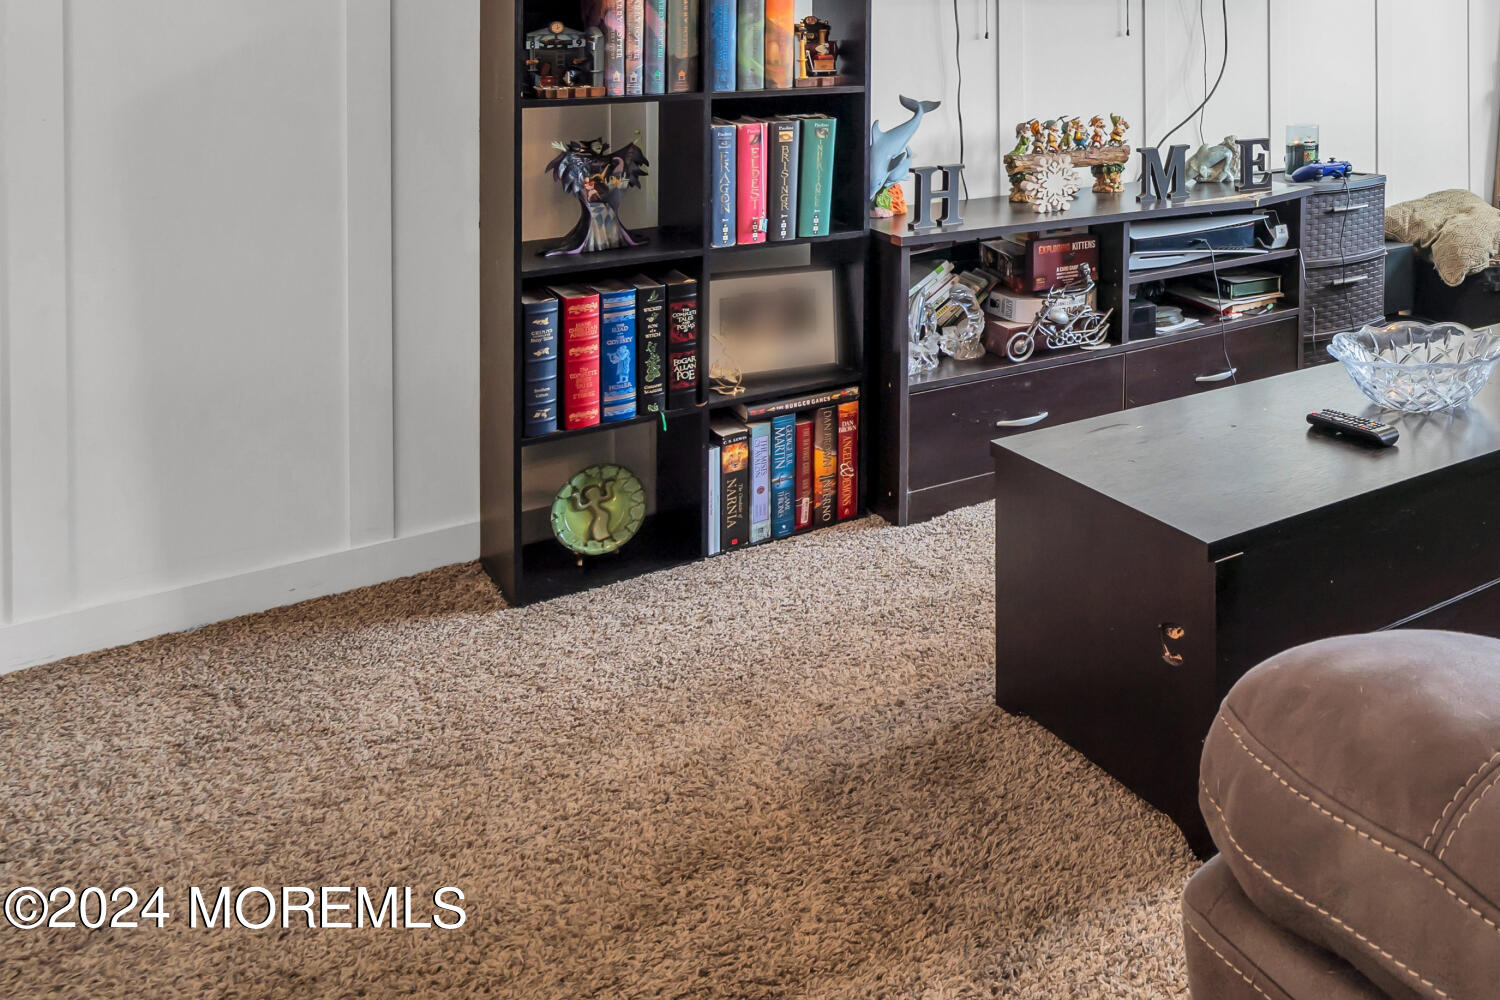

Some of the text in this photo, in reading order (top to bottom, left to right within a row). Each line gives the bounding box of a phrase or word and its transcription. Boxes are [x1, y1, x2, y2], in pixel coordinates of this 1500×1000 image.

[719, 151, 731, 214] ERAGON
[750, 147, 760, 210] ELDEST
[780, 145, 790, 211] BRISINGR
[1072, 239, 1096, 251] KITTENS
[673, 355, 696, 367] EDGAR
[673, 362, 697, 373] ALLAN
[676, 369, 695, 381] POE
[785, 399, 810, 409] HUNGER
[811, 395, 830, 405] GAMES
[823, 410, 832, 468] DAN BROWN
[838, 425, 857, 433] BROWN
[774, 427, 786, 469] MARTIN
[841, 435, 852, 463] ANGELS
[726, 478, 737, 529] NARNIA
[777, 491, 785, 518] THRONES
[819, 472, 836, 521] INFERNO
[841, 475, 852, 506] DEMONS
